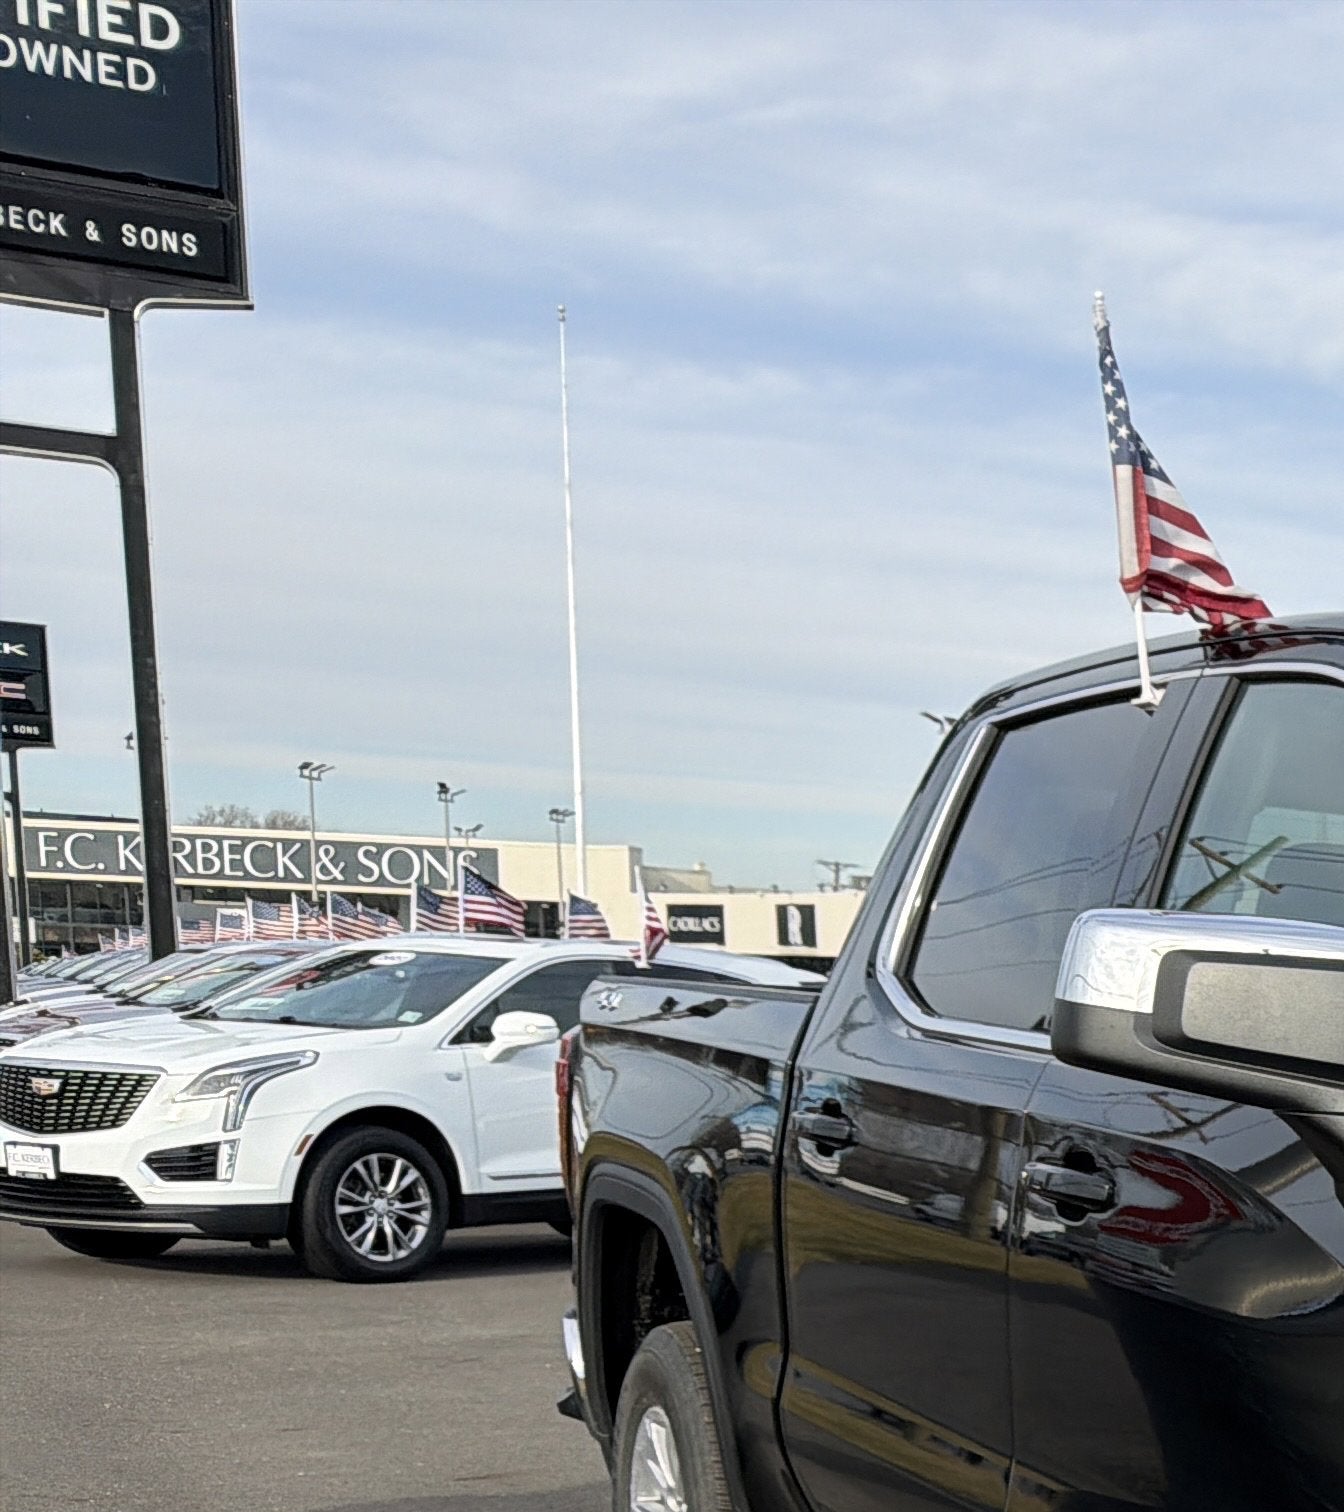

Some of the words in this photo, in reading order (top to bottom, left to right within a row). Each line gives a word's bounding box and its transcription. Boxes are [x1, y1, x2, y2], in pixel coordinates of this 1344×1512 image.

[85, 220, 101, 241] &
[121, 223, 198, 257] SONS
[38, 831, 105, 871] F.C.
[117, 834, 304, 879] KRBECK
[315, 844, 345, 881] &
